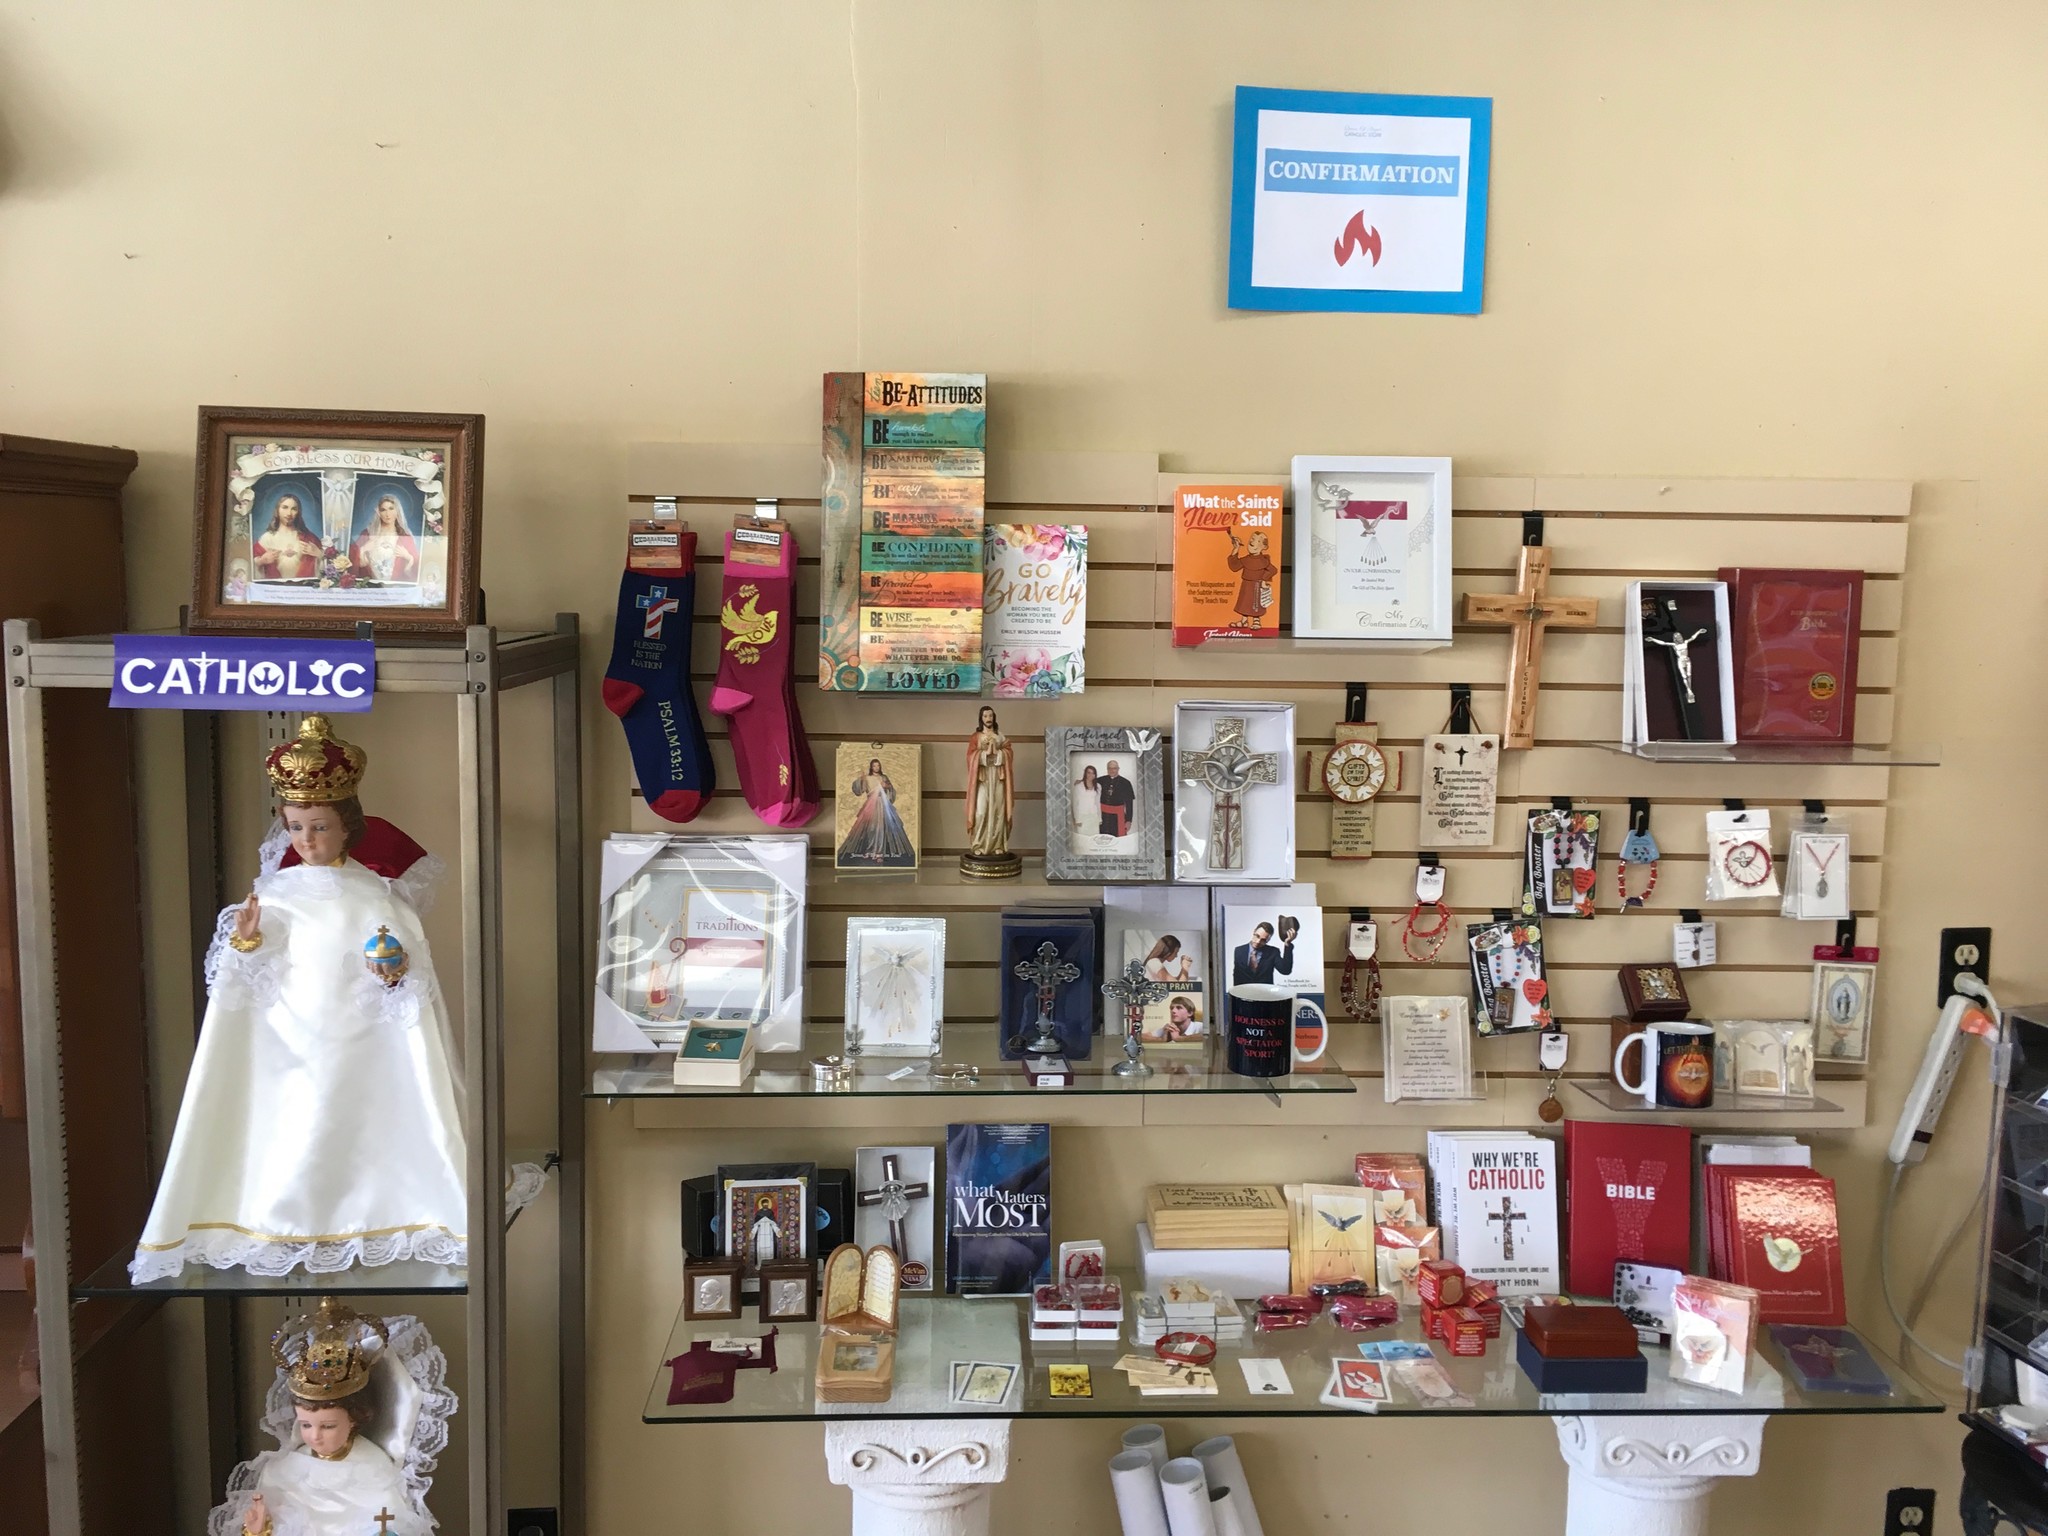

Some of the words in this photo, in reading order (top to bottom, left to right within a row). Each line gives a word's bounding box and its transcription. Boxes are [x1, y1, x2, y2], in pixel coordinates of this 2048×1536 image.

[1269, 160, 1455, 184] CONFIRMATION
[872, 419, 889, 444] BE
[263, 456, 292, 468] GOD
[297, 453, 340, 465] BLESS
[343, 454, 371, 467] OUR
[375, 456, 415, 472] HOME
[872, 454, 887, 469] BE
[873, 484, 895, 498] BE
[898, 484, 921, 496] easy
[1183, 494, 1219, 508] What
[1221, 498, 1236, 508] the
[1237, 494, 1279, 509] Saints
[873, 511, 890, 528] BE
[1183, 507, 1238, 527] Never
[1241, 511, 1272, 526] Said
[872, 542, 885, 552] BE
[888, 542, 973, 553] CONFIDENT
[1018, 563, 1051, 578] GO
[871, 576, 881, 587] BE
[983, 566, 1085, 625] Bravely
[1193, 597, 1204, 605] They
[871, 612, 882, 627] BE
[885, 613, 912, 622] WISE
[1356, 611, 1407, 627] Confirmation
[1409, 617, 1429, 629] Day
[1385, 610, 1404, 619] My
[746, 618, 775, 643] LOVE
[1800, 617, 1827, 631] Bible
[633, 641, 667, 651] BLESSED
[871, 635, 884, 644] BE
[636, 650, 643, 659] IS
[644, 651, 660, 660] THE
[630, 659, 662, 670] NATION
[887, 672, 960, 689] LOVED
[658, 701, 679, 746] PSALM
[671, 746, 683, 781] 33:12
[1065, 728, 1122, 743] Confirmed
[1098, 741, 1126, 749] CHRIST
[1439, 792, 1453, 801] God
[1449, 808, 1465, 818] God
[1438, 818, 1453, 828] God
[1533, 844, 1543, 878] Booster
[1534, 879, 1544, 900] Bag
[1483, 963, 1493, 1002] Booster
[1234, 1015, 1278, 1027] HOLINESS
[1245, 1028, 1265, 1037] NOT
[1266, 1029, 1273, 1037] A
[1235, 1037, 1282, 1048] SPECTATOR
[1244, 1050, 1275, 1058] SPORT!
[1472, 1153, 1498, 1168] WHY
[1502, 1152, 1539, 1167] WE'RE
[1469, 1169, 1545, 1190] CATHOLIC
[955, 1181, 995, 1198] what
[995, 1190, 1046, 1204] Matters
[1606, 1183, 1656, 1200] BIBLE
[953, 1198, 1047, 1228] MOST
